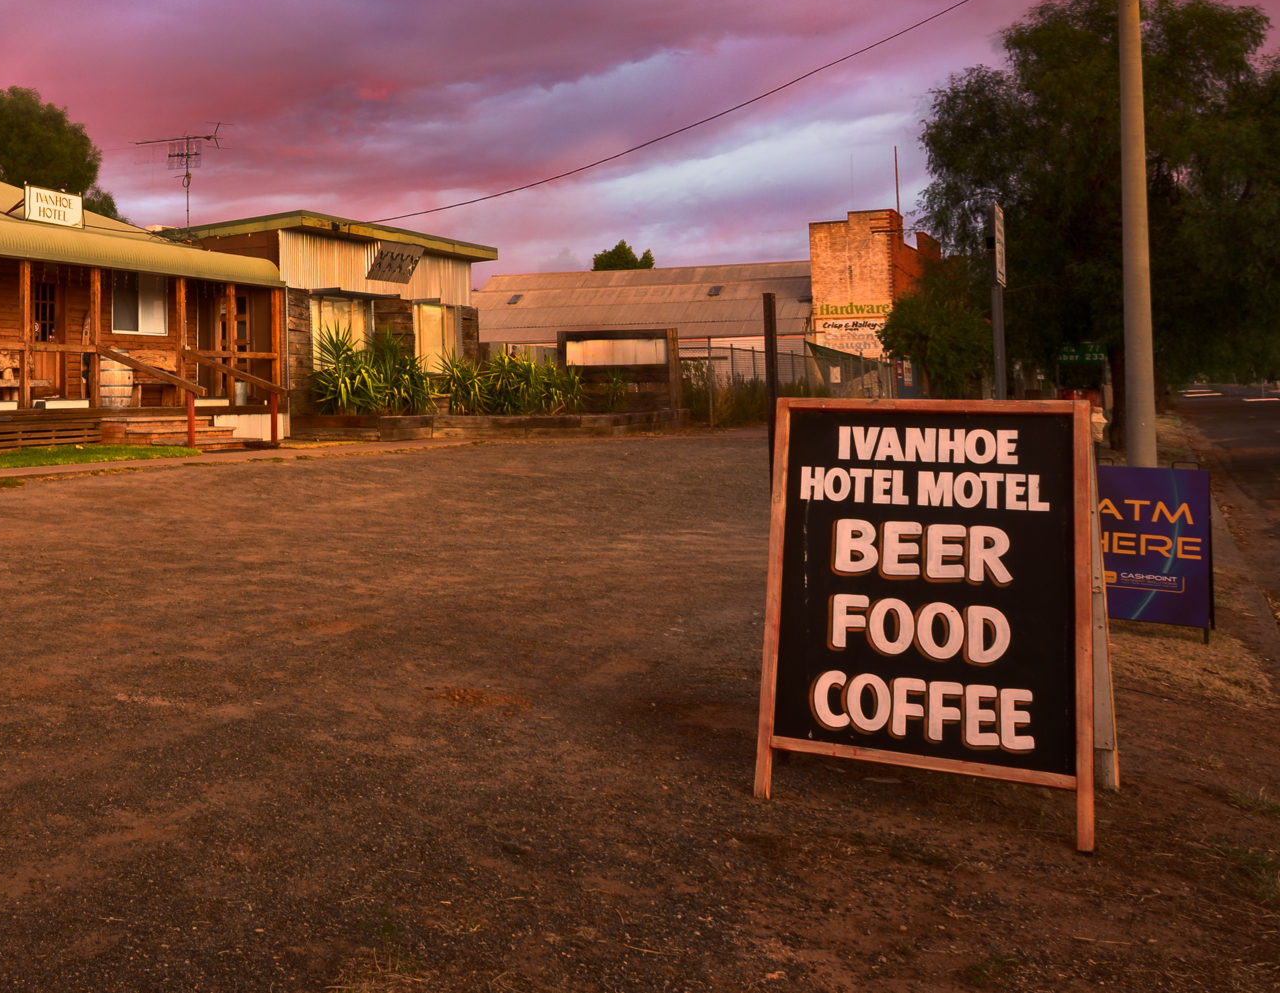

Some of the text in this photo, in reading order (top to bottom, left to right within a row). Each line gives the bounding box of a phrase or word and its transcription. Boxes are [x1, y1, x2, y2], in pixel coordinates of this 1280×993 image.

[36, 192, 73, 209] IVANHOE
[39, 207, 66, 221] HOTEL
[820, 302, 890, 316] Hardware
[822, 321, 843, 329] Crisp
[837, 425, 1019, 465] IVANHOE
[799, 465, 1051, 512] HOTEL MOTEL
[1098, 498, 1194, 525] ATM
[831, 518, 1014, 587] BEER
[1120, 572, 1178, 582] CASHPOINT
[827, 593, 1011, 666] FOOD
[810, 669, 1036, 753] COFFEE
